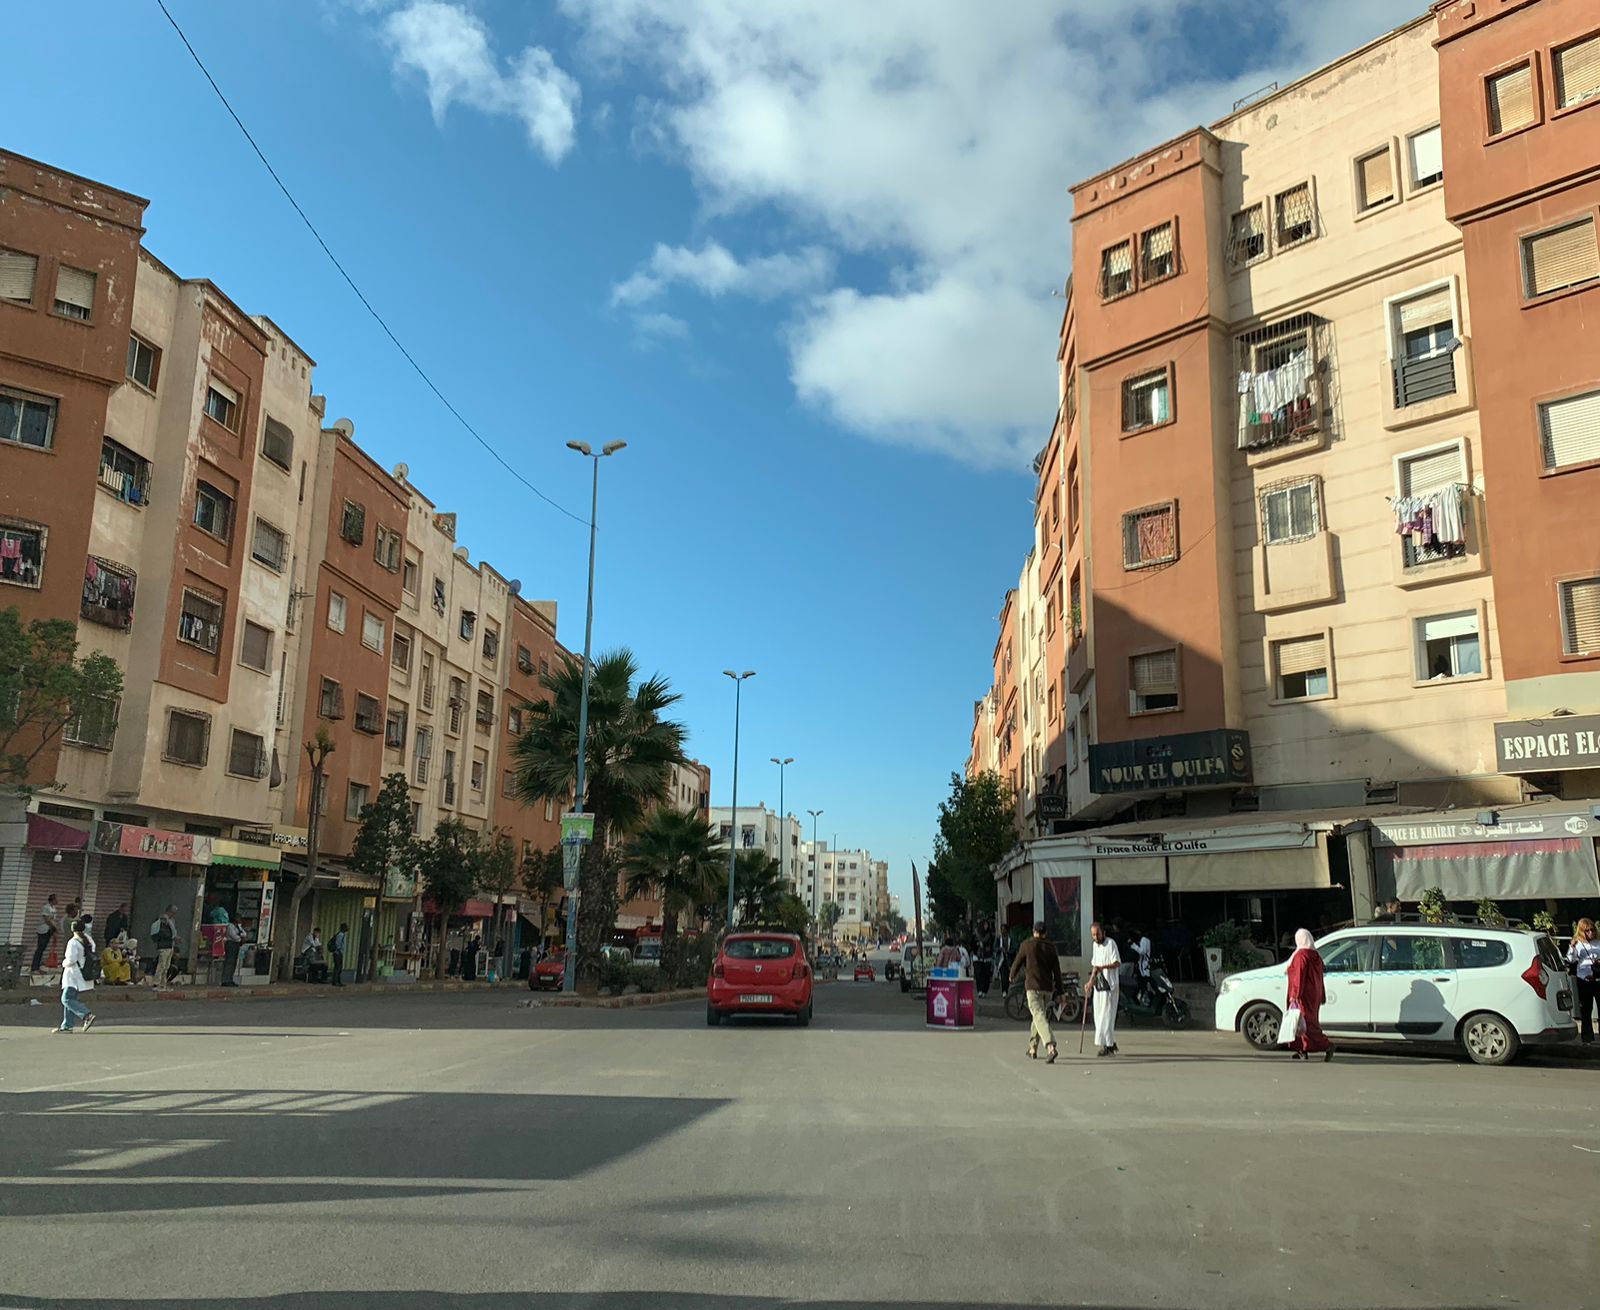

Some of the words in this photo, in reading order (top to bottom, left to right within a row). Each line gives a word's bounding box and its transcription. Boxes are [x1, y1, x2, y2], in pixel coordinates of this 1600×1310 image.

[1502, 733, 1570, 760] ESPACE
[1575, 731, 1599, 755] EL
[1101, 765, 1145, 784] NOUR
[1149, 762, 1168, 780] EL
[1171, 756, 1226, 779] OULFA
[1409, 827, 1419, 840] EL
[1096, 845, 1130, 855] Espace
[1132, 844, 1158, 853] Nour
[1161, 842, 1172, 851] El
[1175, 840, 1207, 851] Oulfa
